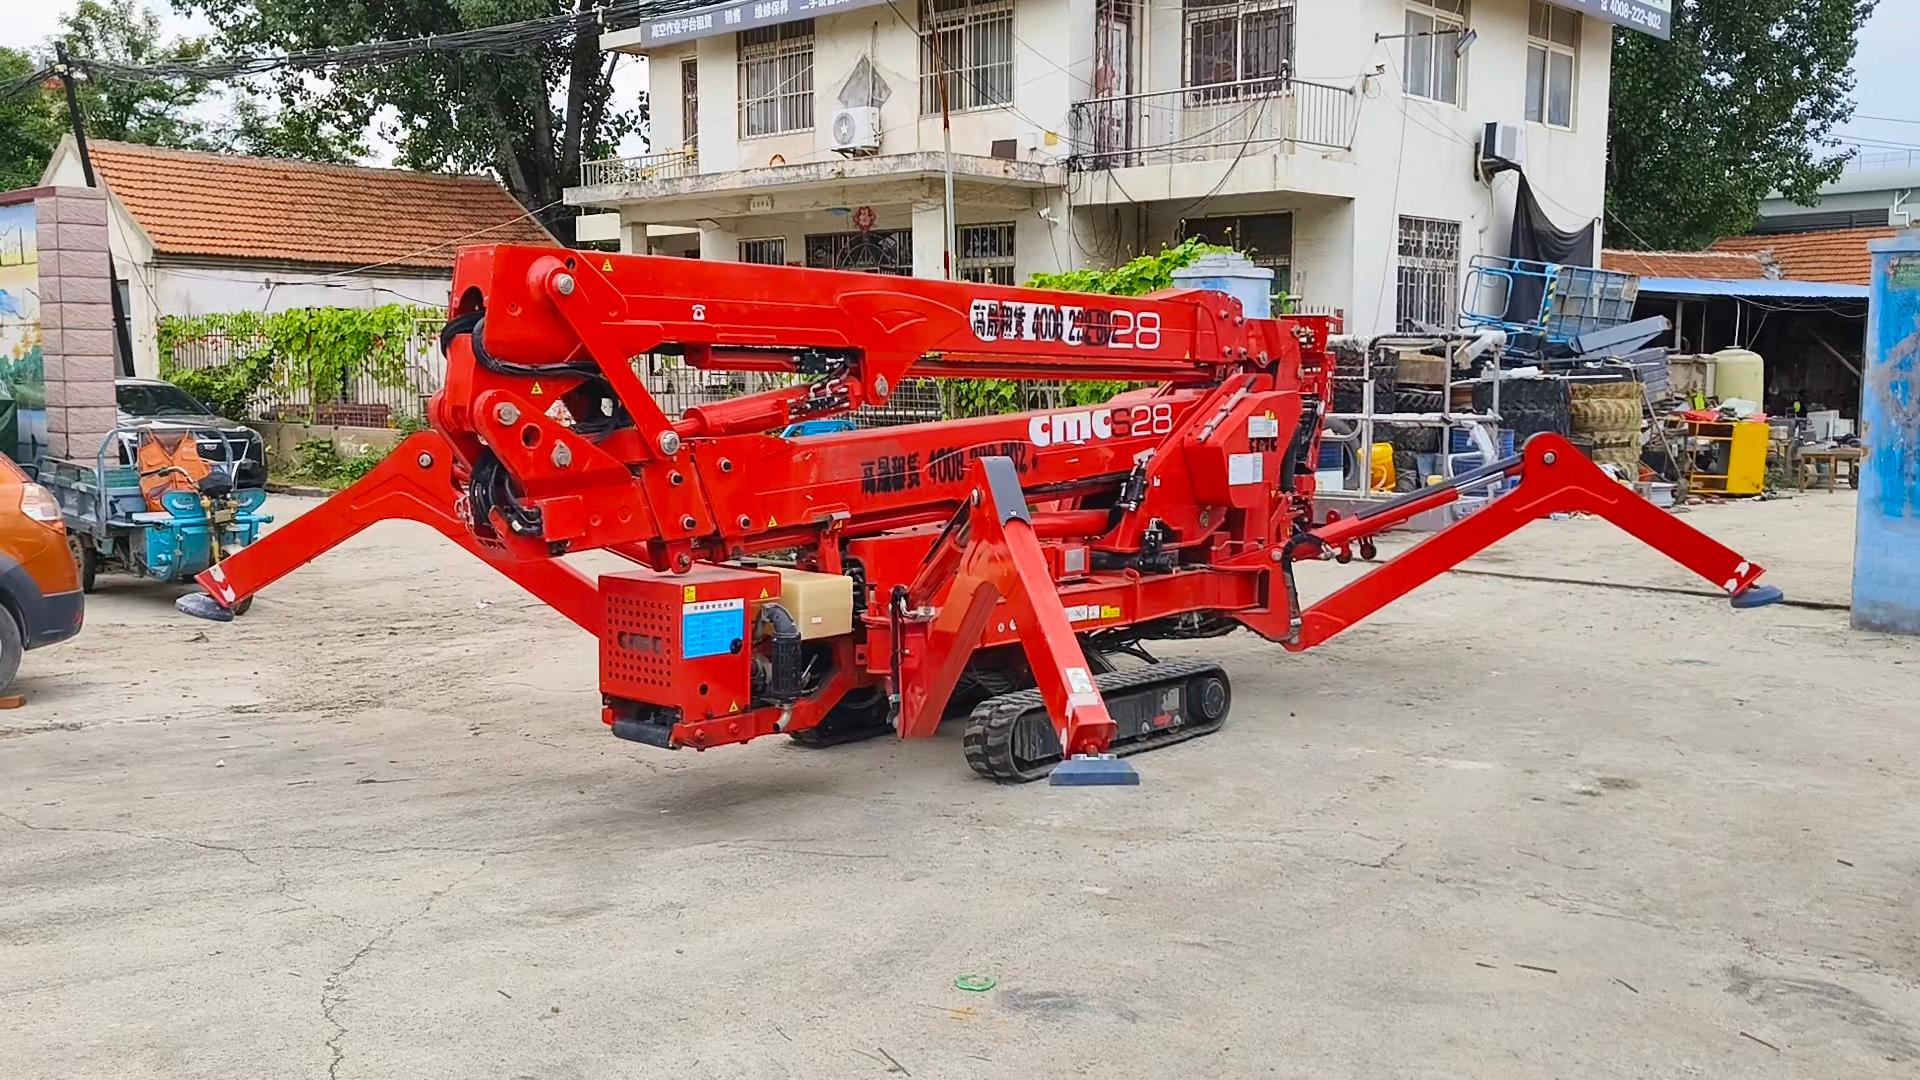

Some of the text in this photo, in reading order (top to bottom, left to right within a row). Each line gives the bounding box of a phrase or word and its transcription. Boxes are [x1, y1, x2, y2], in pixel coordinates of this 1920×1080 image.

[1610, 0, 1662, 30] 4008-222-802
[1032, 306, 1064, 340] 4008
[929, 446, 965, 485] 4008
